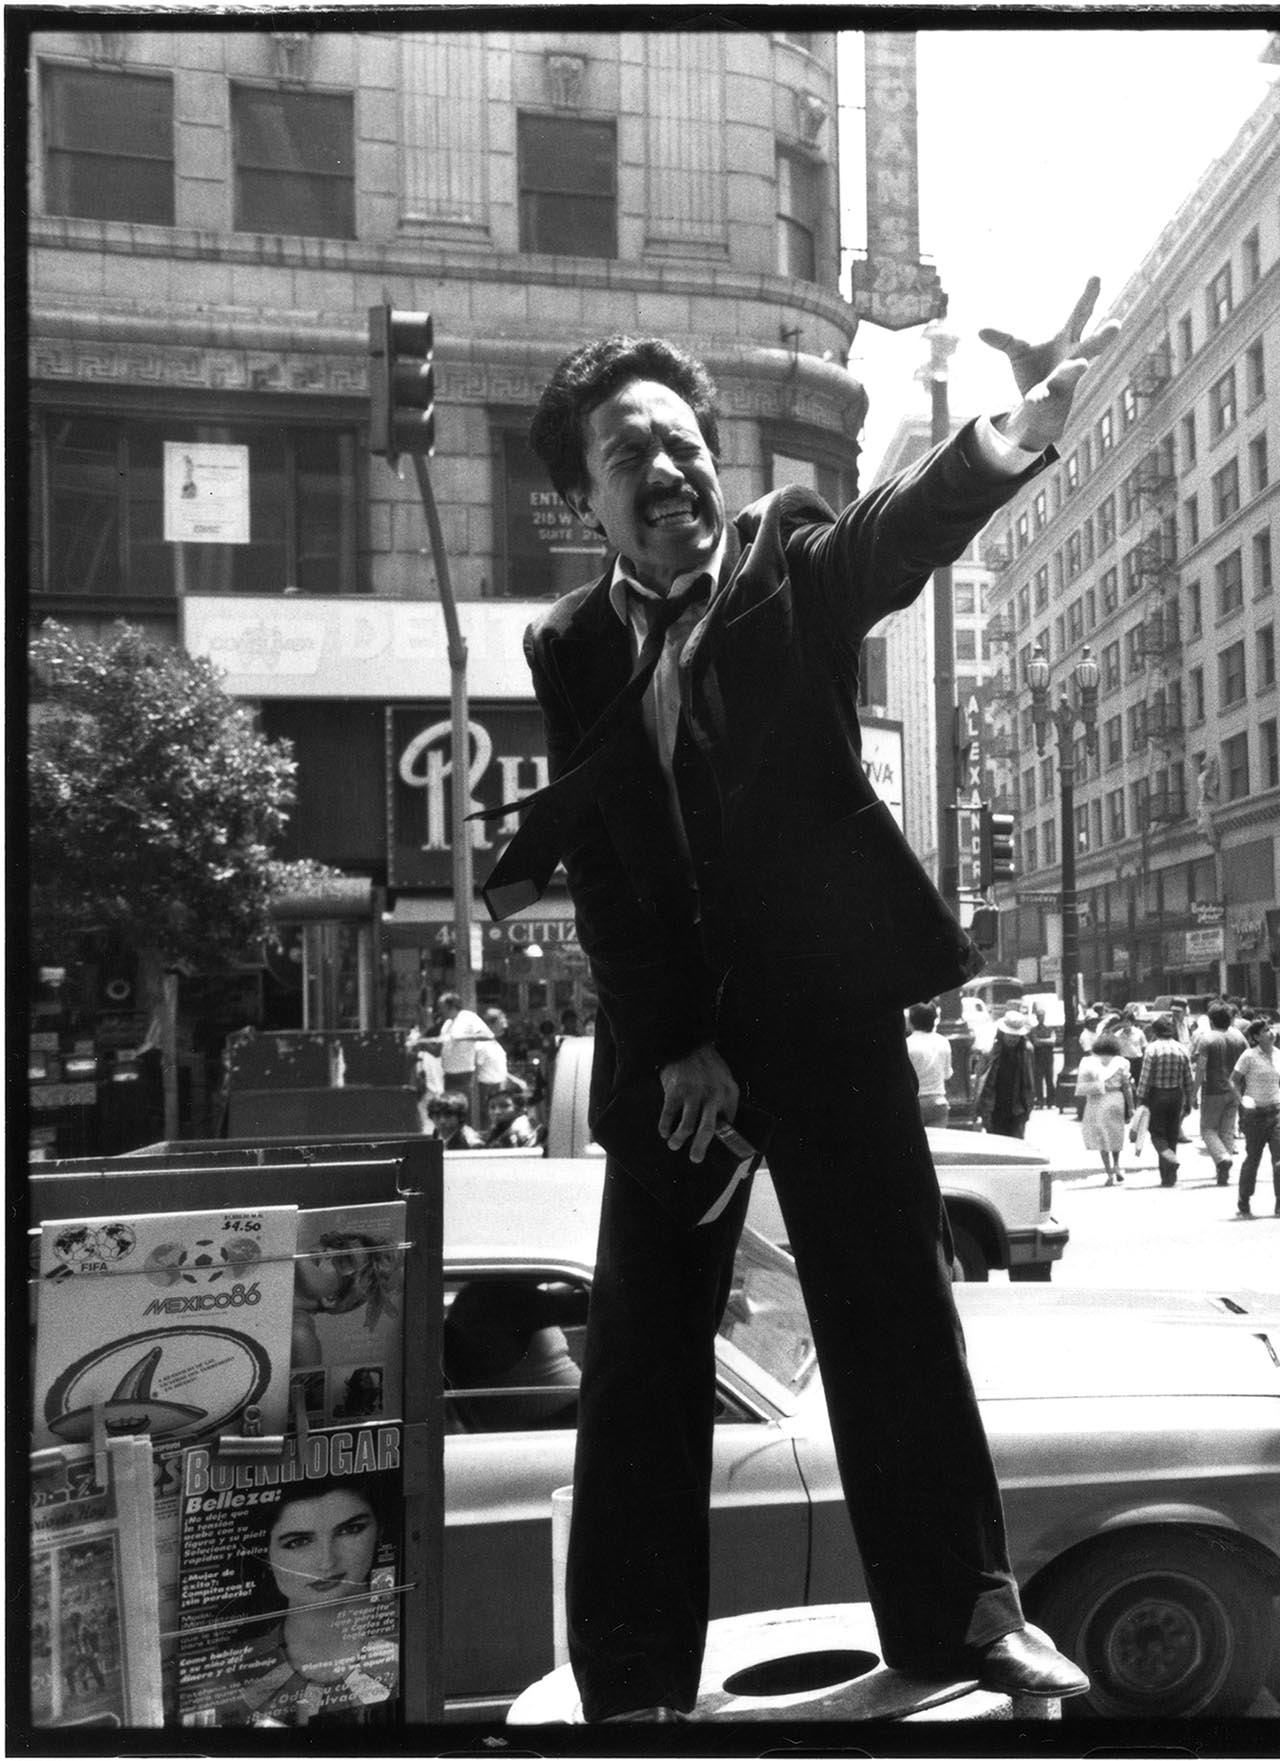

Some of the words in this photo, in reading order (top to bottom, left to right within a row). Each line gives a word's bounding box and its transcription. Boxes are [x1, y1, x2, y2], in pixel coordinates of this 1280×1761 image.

[530, 491, 565, 506] ENT
[81, 1262, 109, 1273] FIFA
[185, 1489, 282, 1515] Belleza:
